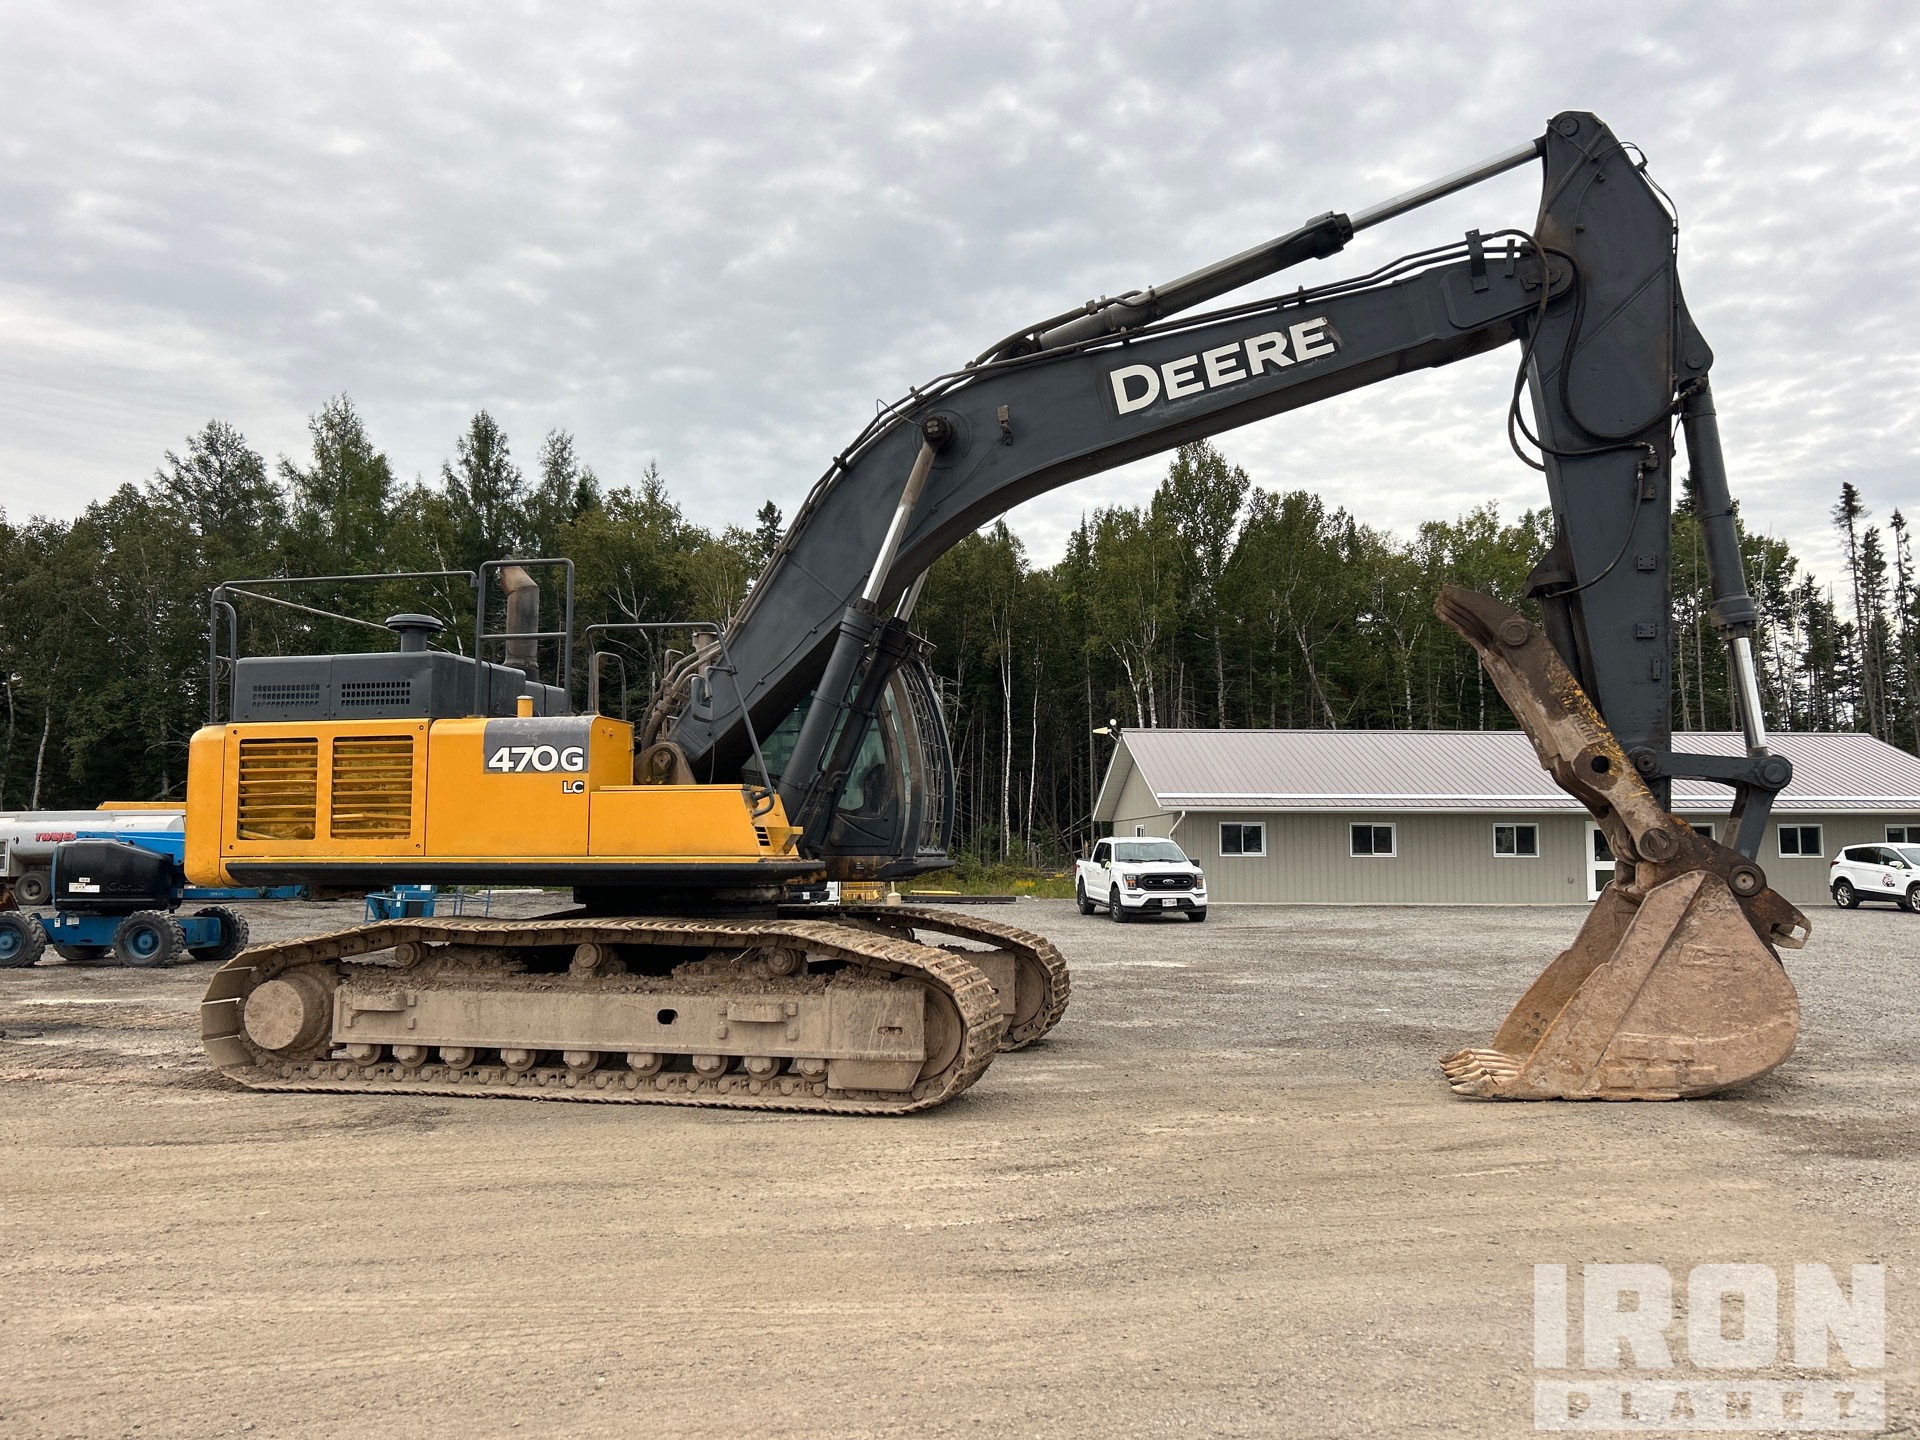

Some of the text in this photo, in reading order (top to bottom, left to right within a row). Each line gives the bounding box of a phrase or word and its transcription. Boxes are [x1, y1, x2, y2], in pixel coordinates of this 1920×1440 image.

[1110, 316, 1336, 415] DEERE
[488, 744, 584, 773] 470G
[563, 780, 584, 794] LC
